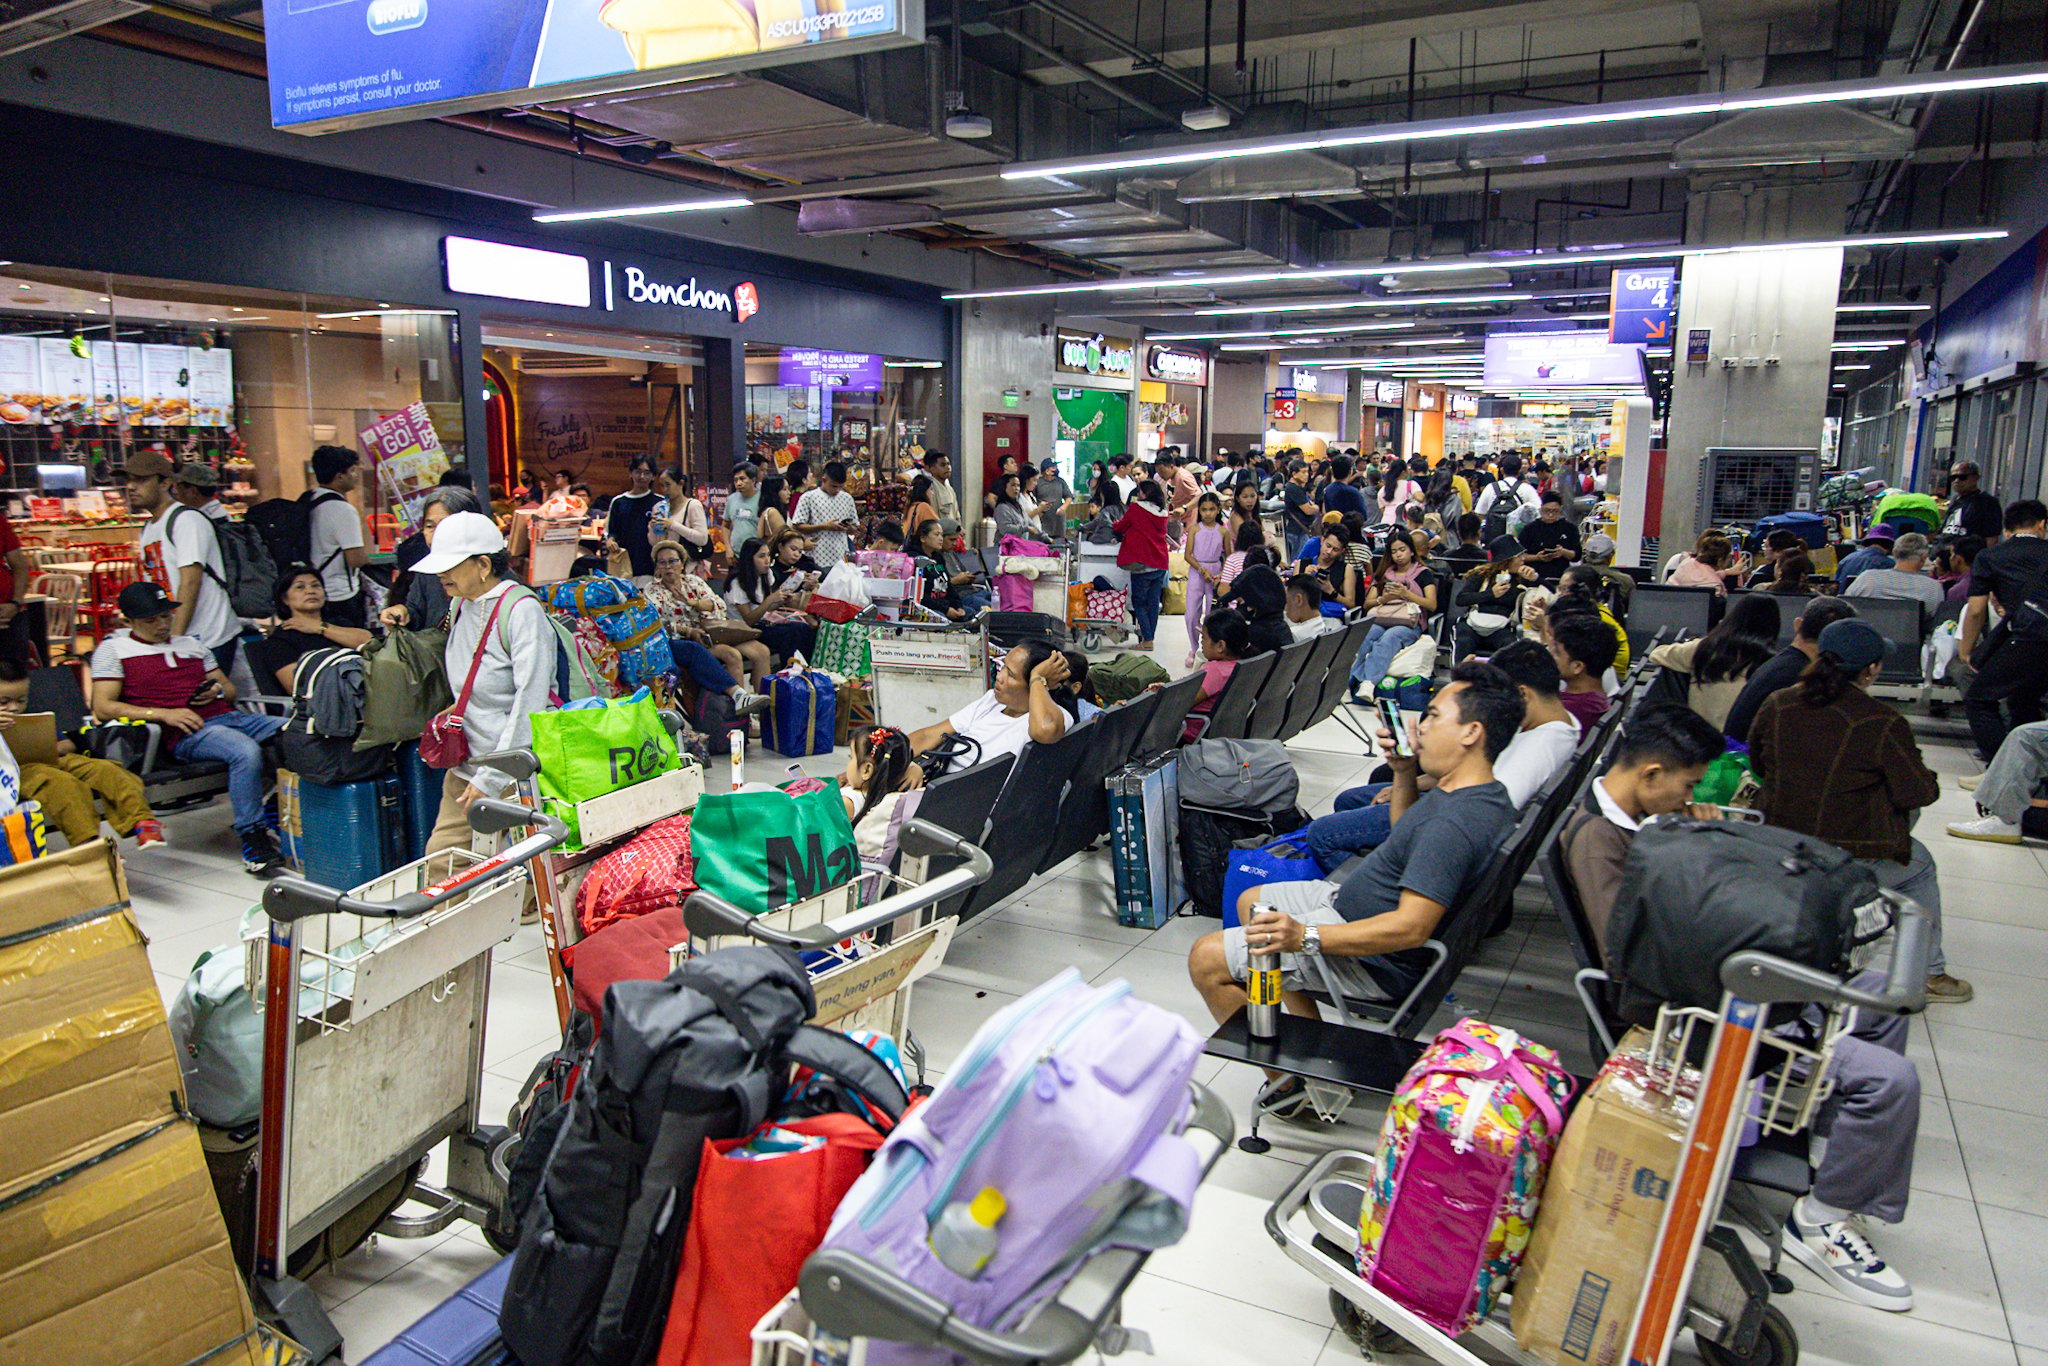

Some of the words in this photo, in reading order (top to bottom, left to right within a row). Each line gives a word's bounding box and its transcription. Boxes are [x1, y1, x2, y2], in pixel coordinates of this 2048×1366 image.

[285, 86, 307, 100] Bioflu
[308, 82, 338, 96] relieves
[339, 74, 379, 92] symptoms
[381, 69, 390, 82] of
[391, 68, 404, 81] flu.
[286, 101, 292, 113] If
[293, 96, 332, 114] symptoms
[333, 91, 361, 108] persist,
[363, 85, 392, 101] consult
[393, 82, 412, 99] your
[414, 78, 442, 93] doctor.
[625, 267, 732, 312] Bonchon
[1626, 274, 1670, 291] GATE
[1651, 289, 1668, 308] 4
[1283, 401, 1295, 418] 3
[375, 414, 407, 437] LET'S
[383, 425, 416, 454] GO!
[537, 413, 580, 441] Freshly
[547, 432, 590, 460] Cooked
[876, 649, 894, 657] Push
[906, 651, 920, 659] lang
[820, 993, 841, 1009] mo
[844, 978, 871, 999] lang
[1617, 1157, 1633, 1192] INSTANT
